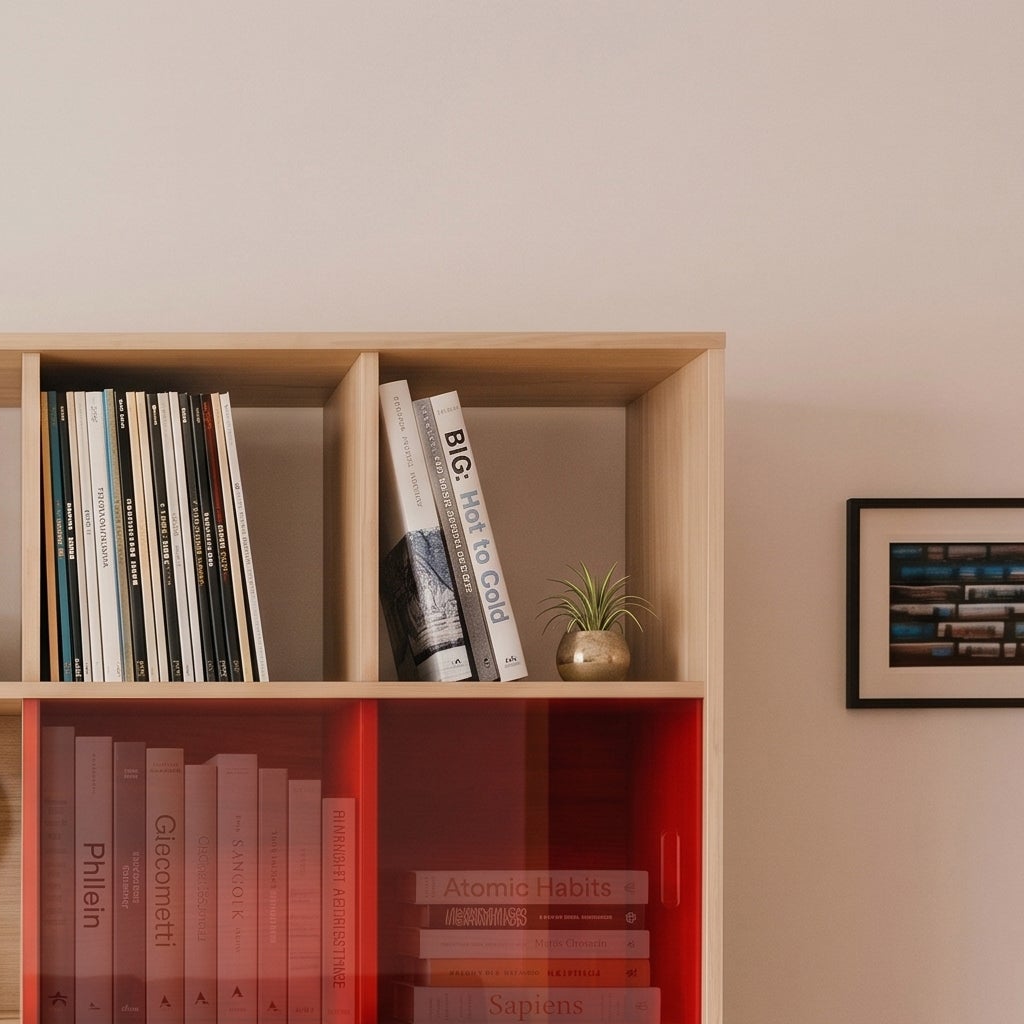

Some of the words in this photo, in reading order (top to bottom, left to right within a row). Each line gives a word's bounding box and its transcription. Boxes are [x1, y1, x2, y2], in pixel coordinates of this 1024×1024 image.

[460, 489, 487, 534] Hot
[473, 538, 491, 565] to
[480, 569, 510, 625] Cold
[443, 877, 529, 897] Atomic
[537, 877, 611, 897] Habits
[489, 994, 584, 1022] Sapiens
